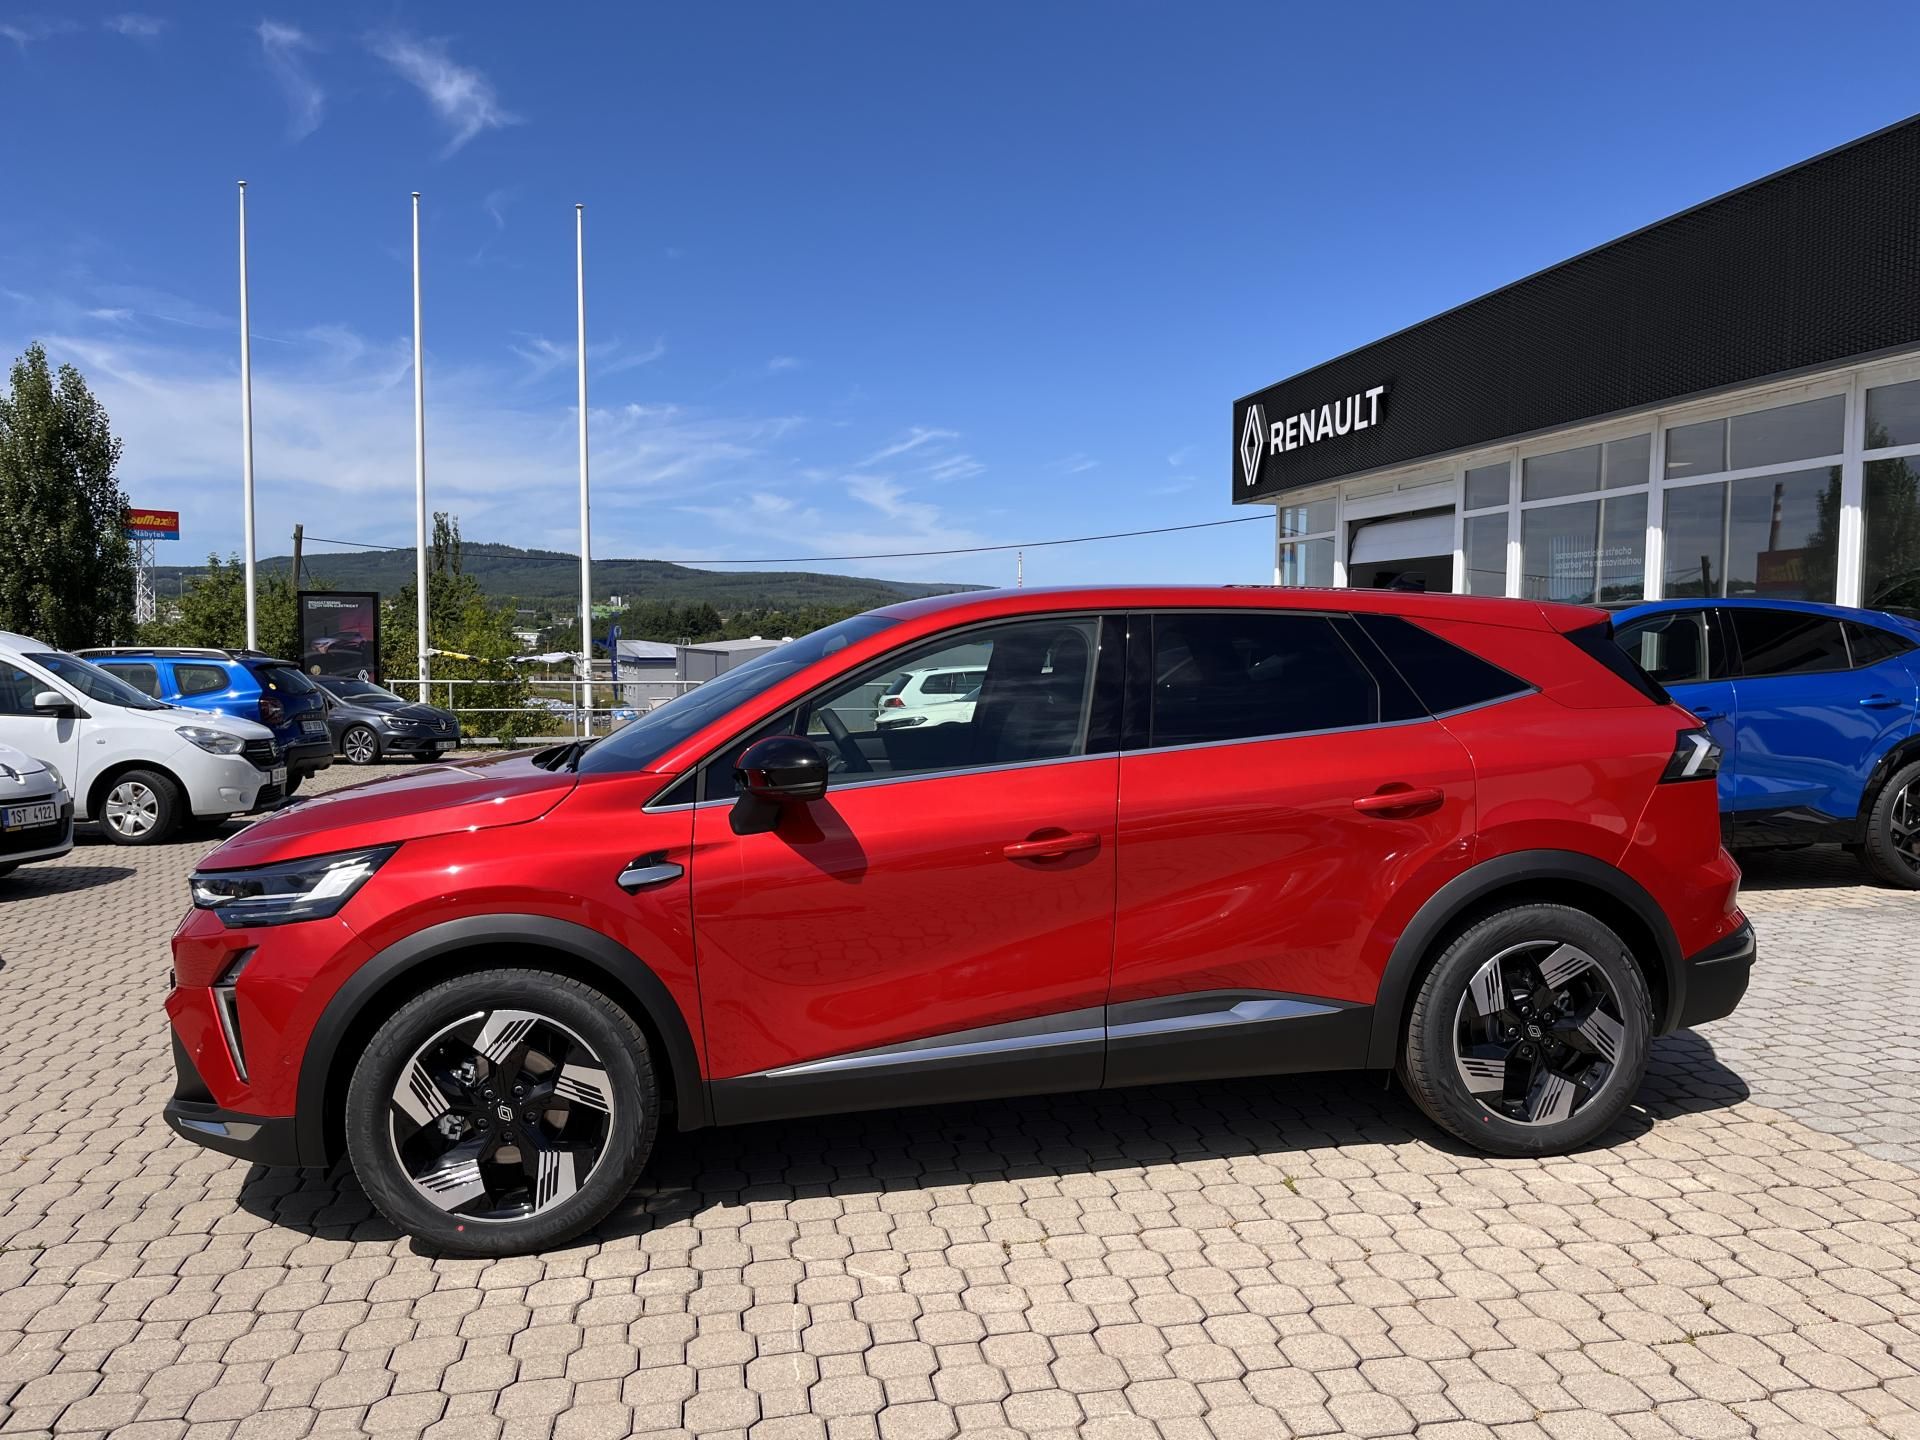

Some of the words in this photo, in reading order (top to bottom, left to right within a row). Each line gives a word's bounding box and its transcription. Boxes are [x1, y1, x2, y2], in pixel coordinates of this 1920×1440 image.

[1270, 385, 1384, 456] RENAULT
[11, 809, 27, 824] 1ST
[34, 806, 52, 819] 4122
